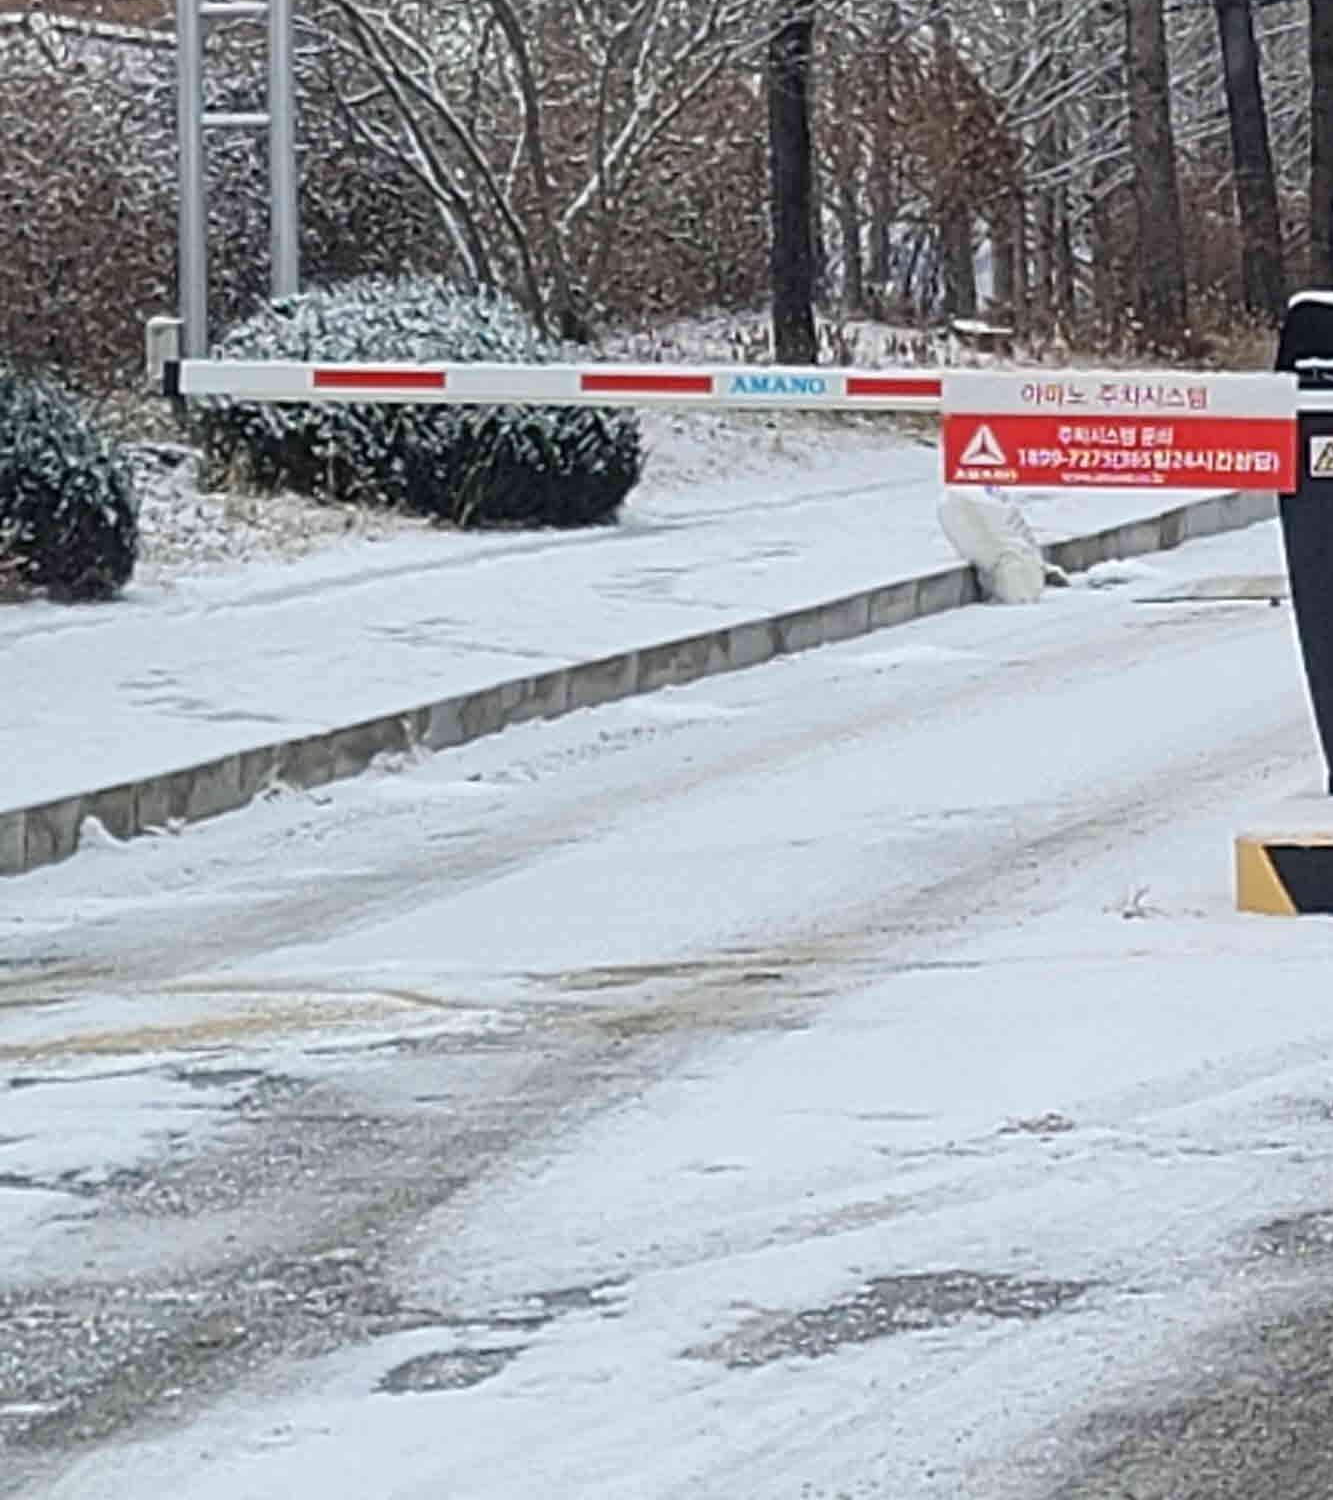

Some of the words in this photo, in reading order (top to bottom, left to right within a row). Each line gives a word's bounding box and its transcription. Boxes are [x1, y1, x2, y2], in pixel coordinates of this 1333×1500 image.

[730, 376, 826, 394] AMANO
[1021, 383, 1087, 407] 아마노
[1098, 384, 1207, 410] 주차시스템
[1058, 425, 1137, 448] 주차시스템
